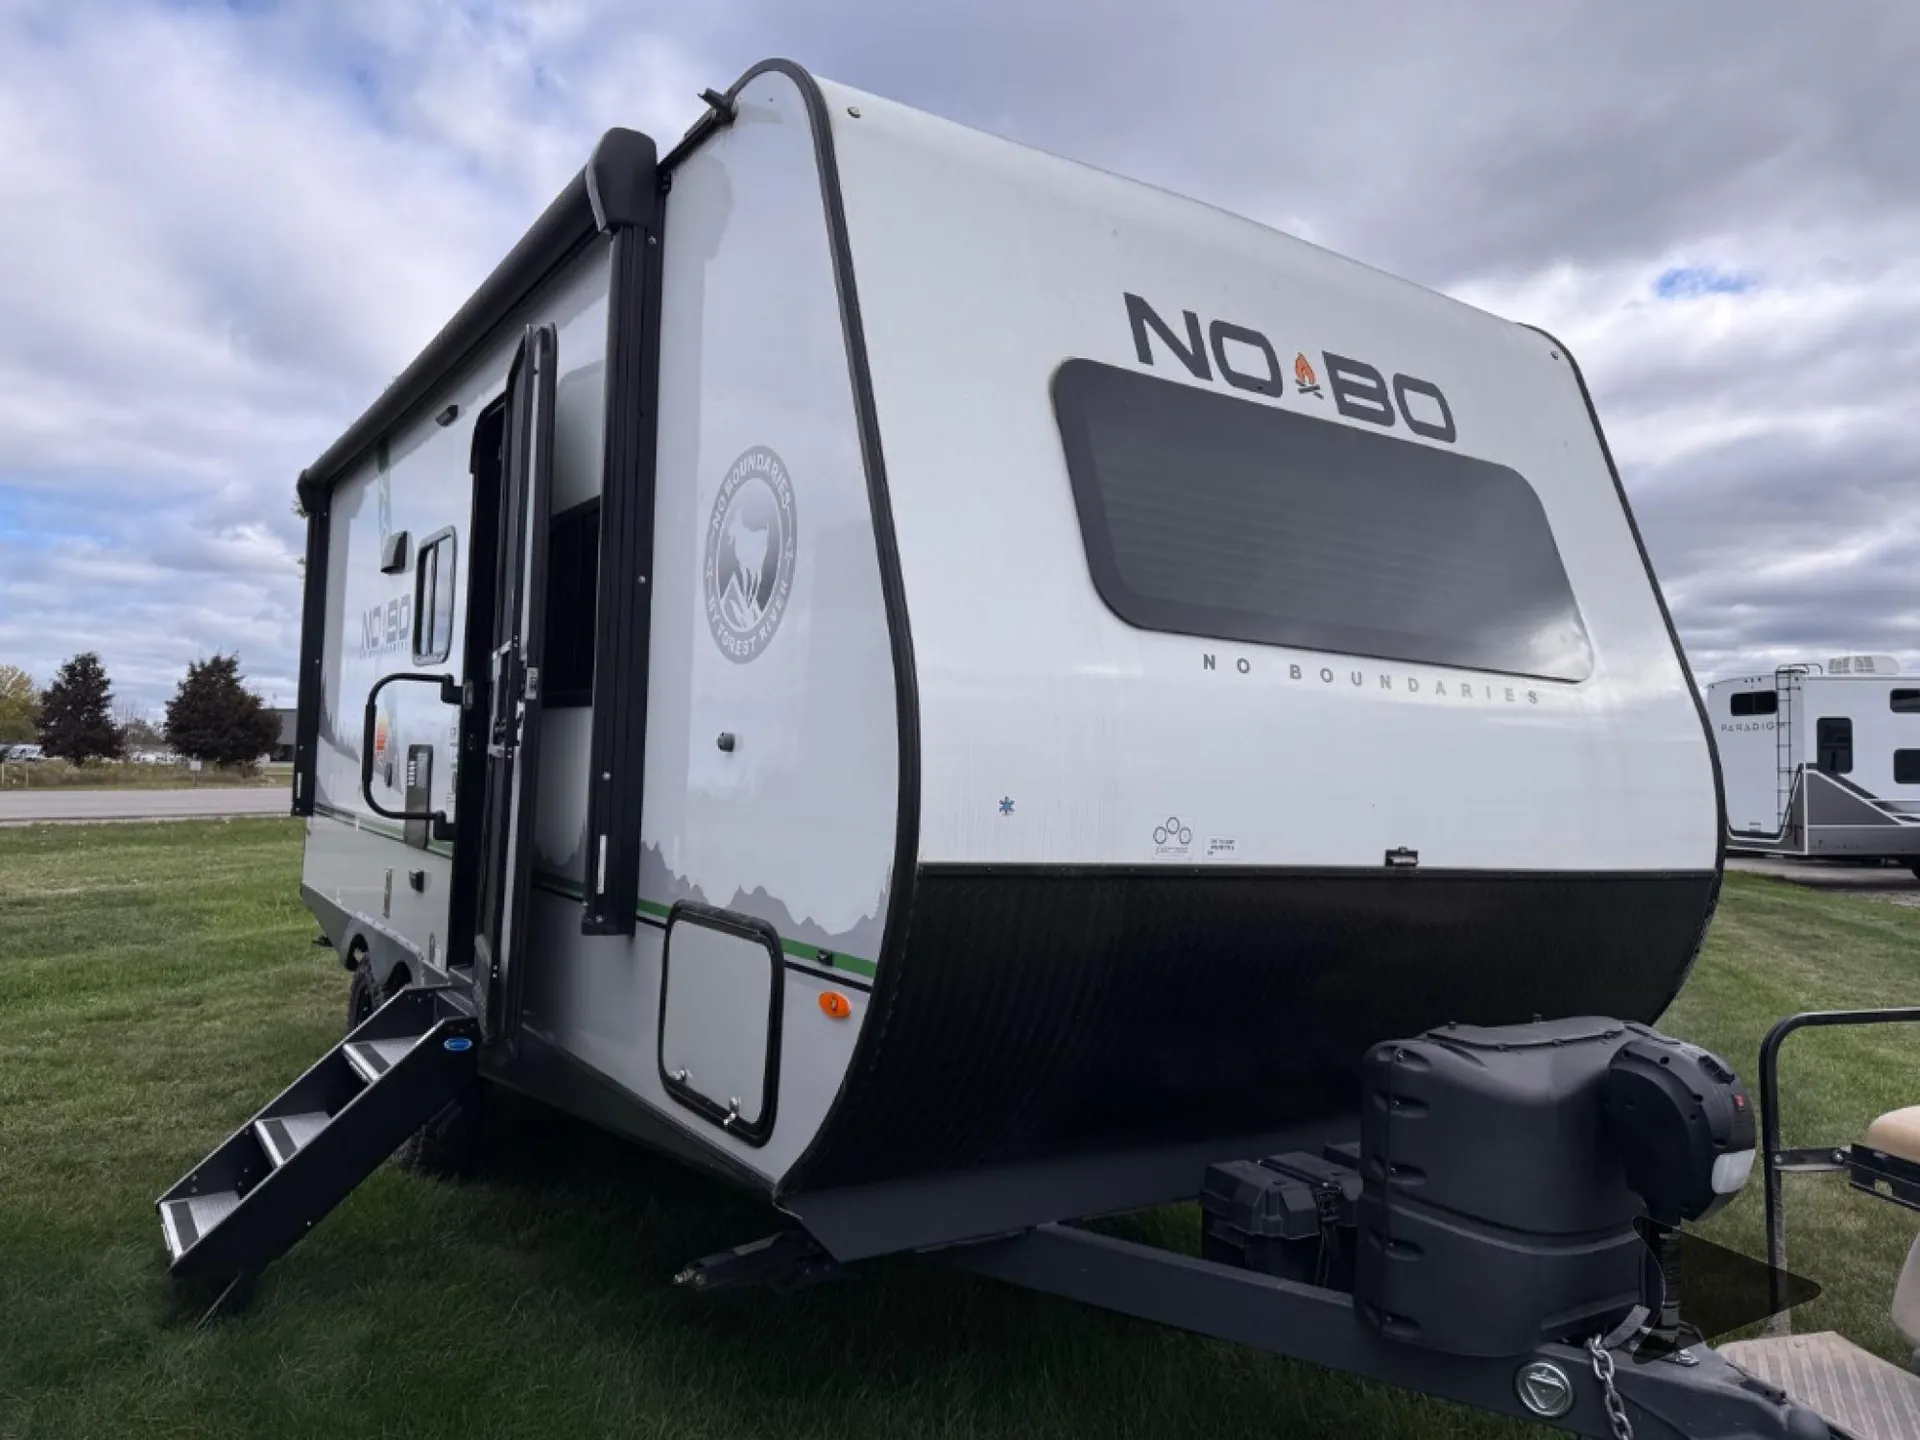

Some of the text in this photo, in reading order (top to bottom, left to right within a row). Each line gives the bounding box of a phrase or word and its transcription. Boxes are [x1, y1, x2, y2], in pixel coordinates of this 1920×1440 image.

[1123, 292, 1456, 442] NO BO
[718, 622, 757, 656] FOREST
[1203, 654, 1538, 704] NO BOUNDARIES
